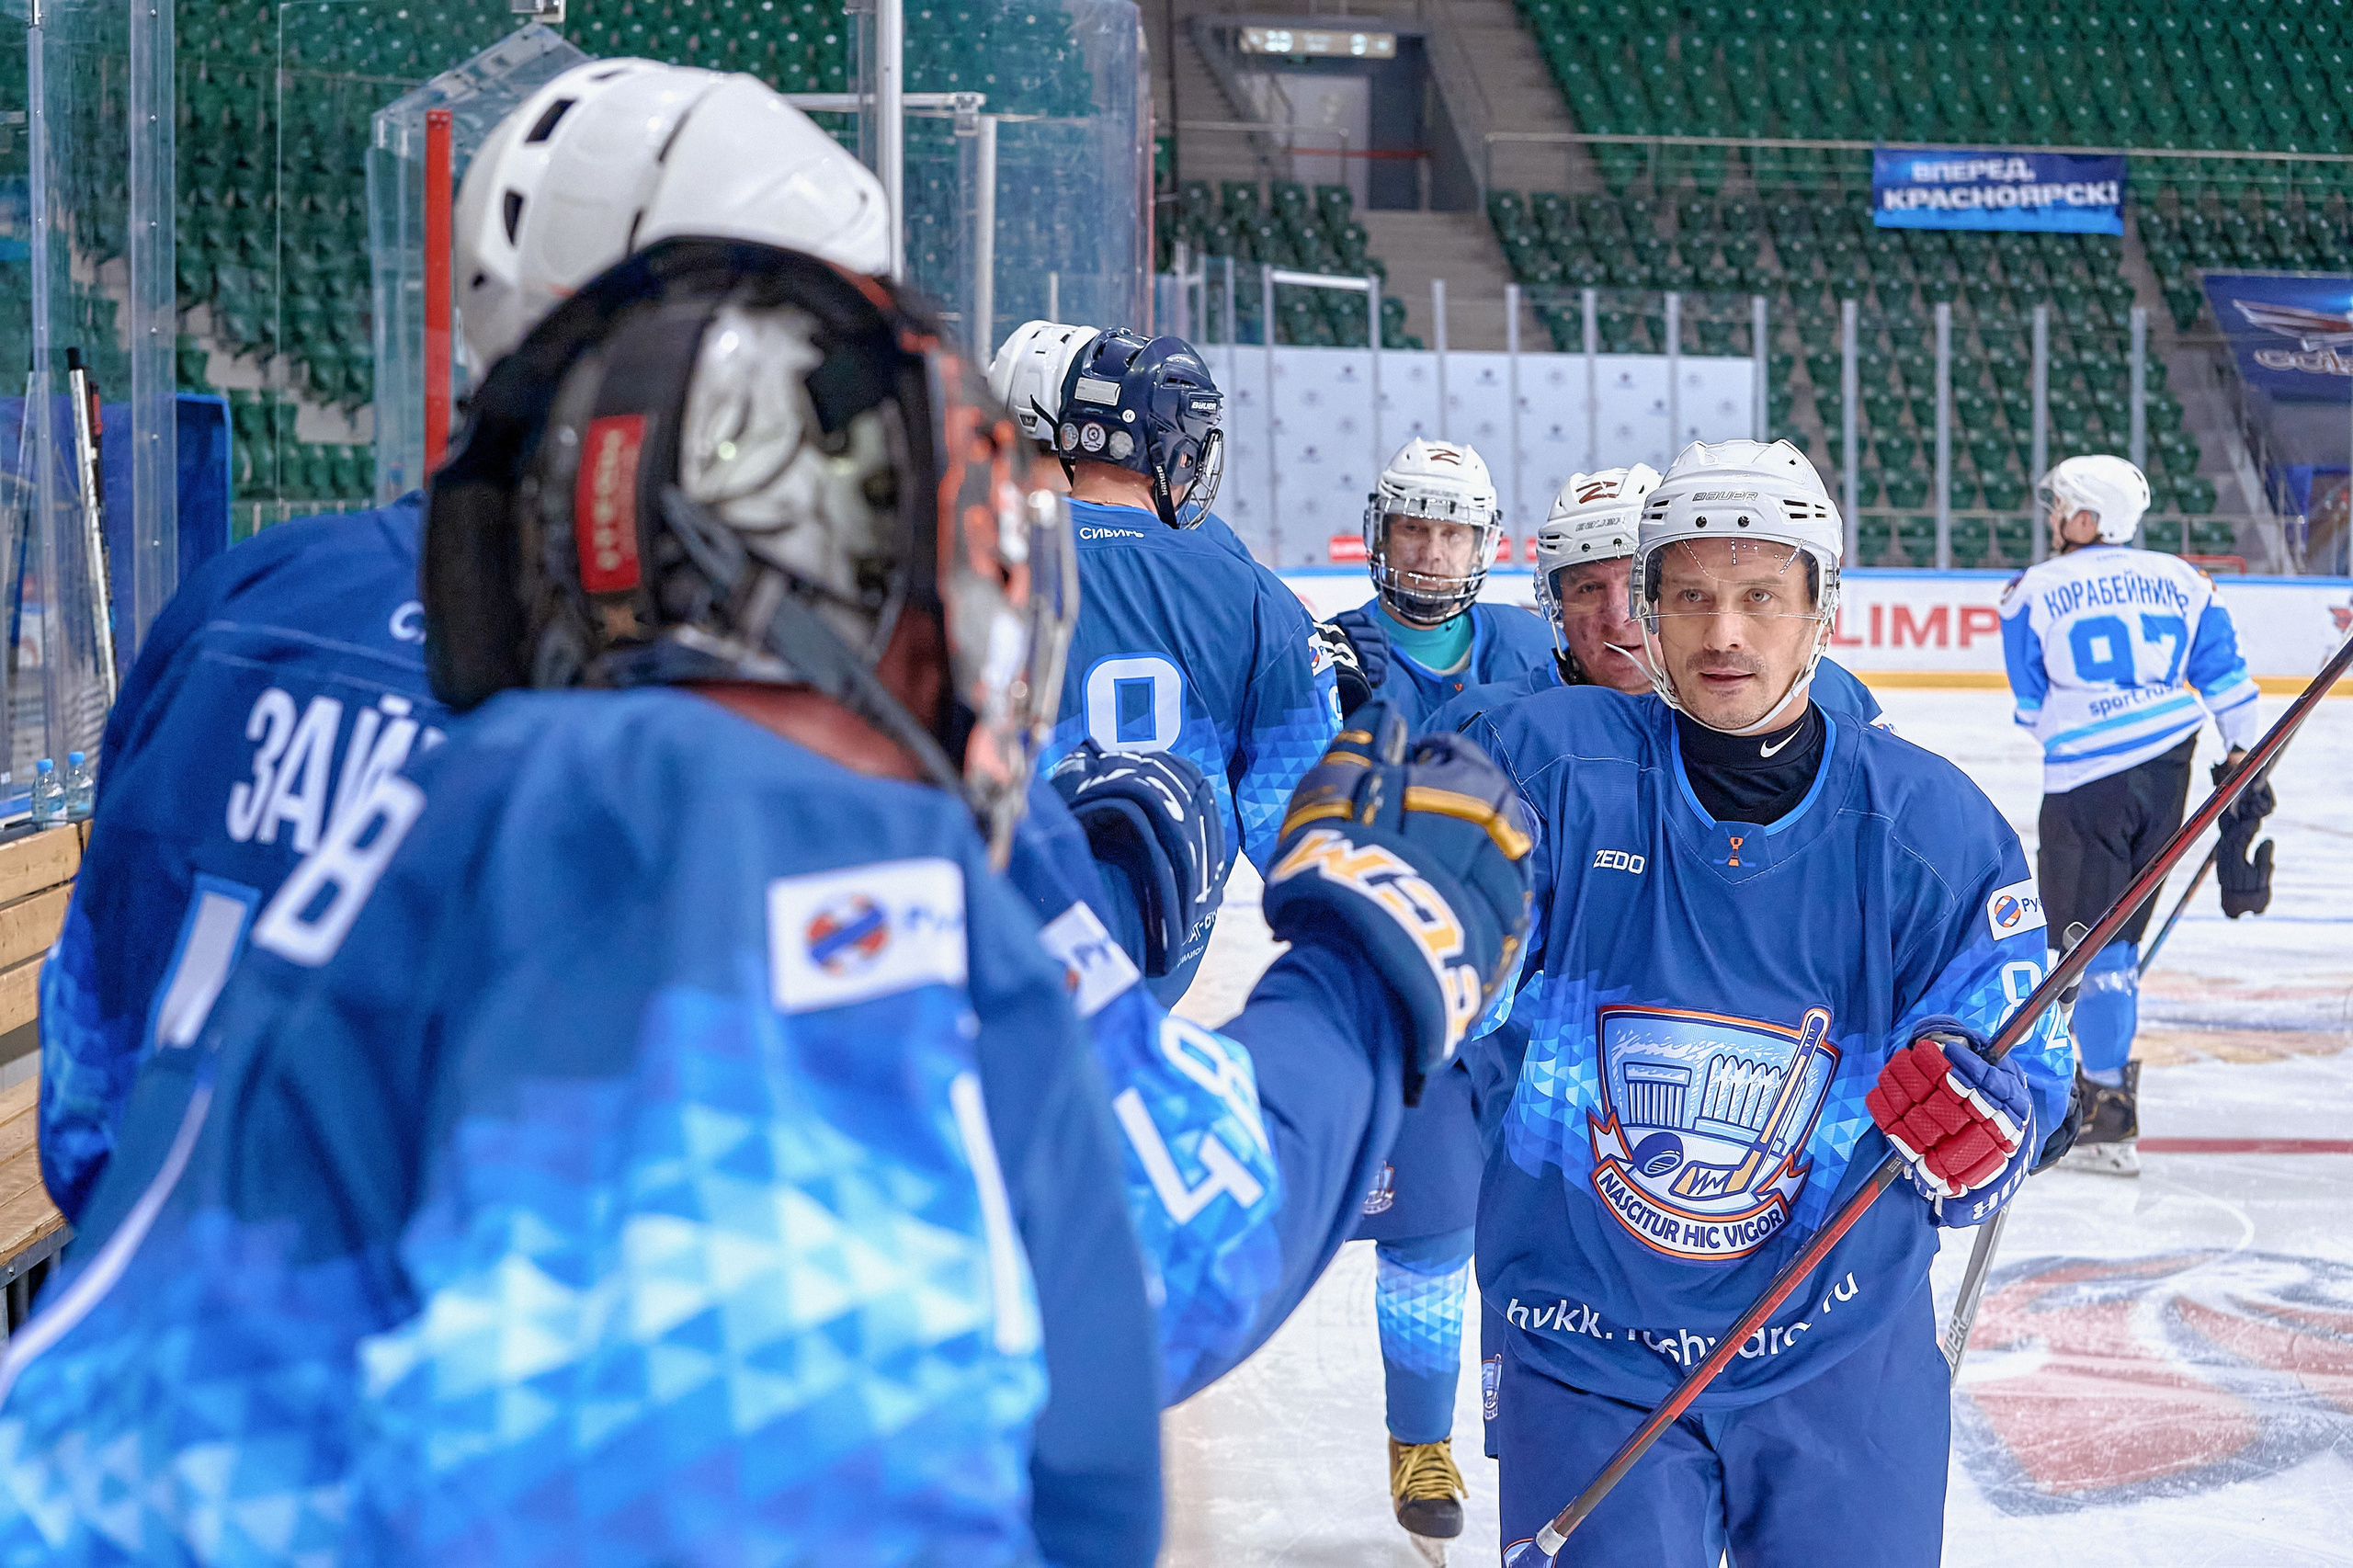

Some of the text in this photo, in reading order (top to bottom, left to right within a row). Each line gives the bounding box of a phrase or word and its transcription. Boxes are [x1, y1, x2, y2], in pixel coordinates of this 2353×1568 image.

[1882, 180, 2120, 211] КРАСНОЯРСК!
[1191, 401, 1217, 411] BAUER
[1155, 465, 1167, 496] BAUER
[1692, 491, 1758, 502] BAUER
[2068, 613, 2189, 689] 97
[225, 687, 449, 855] ЗАЙ
[1592, 849, 1646, 875] ZEDO
[1598, 1172, 1784, 1249] NASCITUR HIC VIGOR
